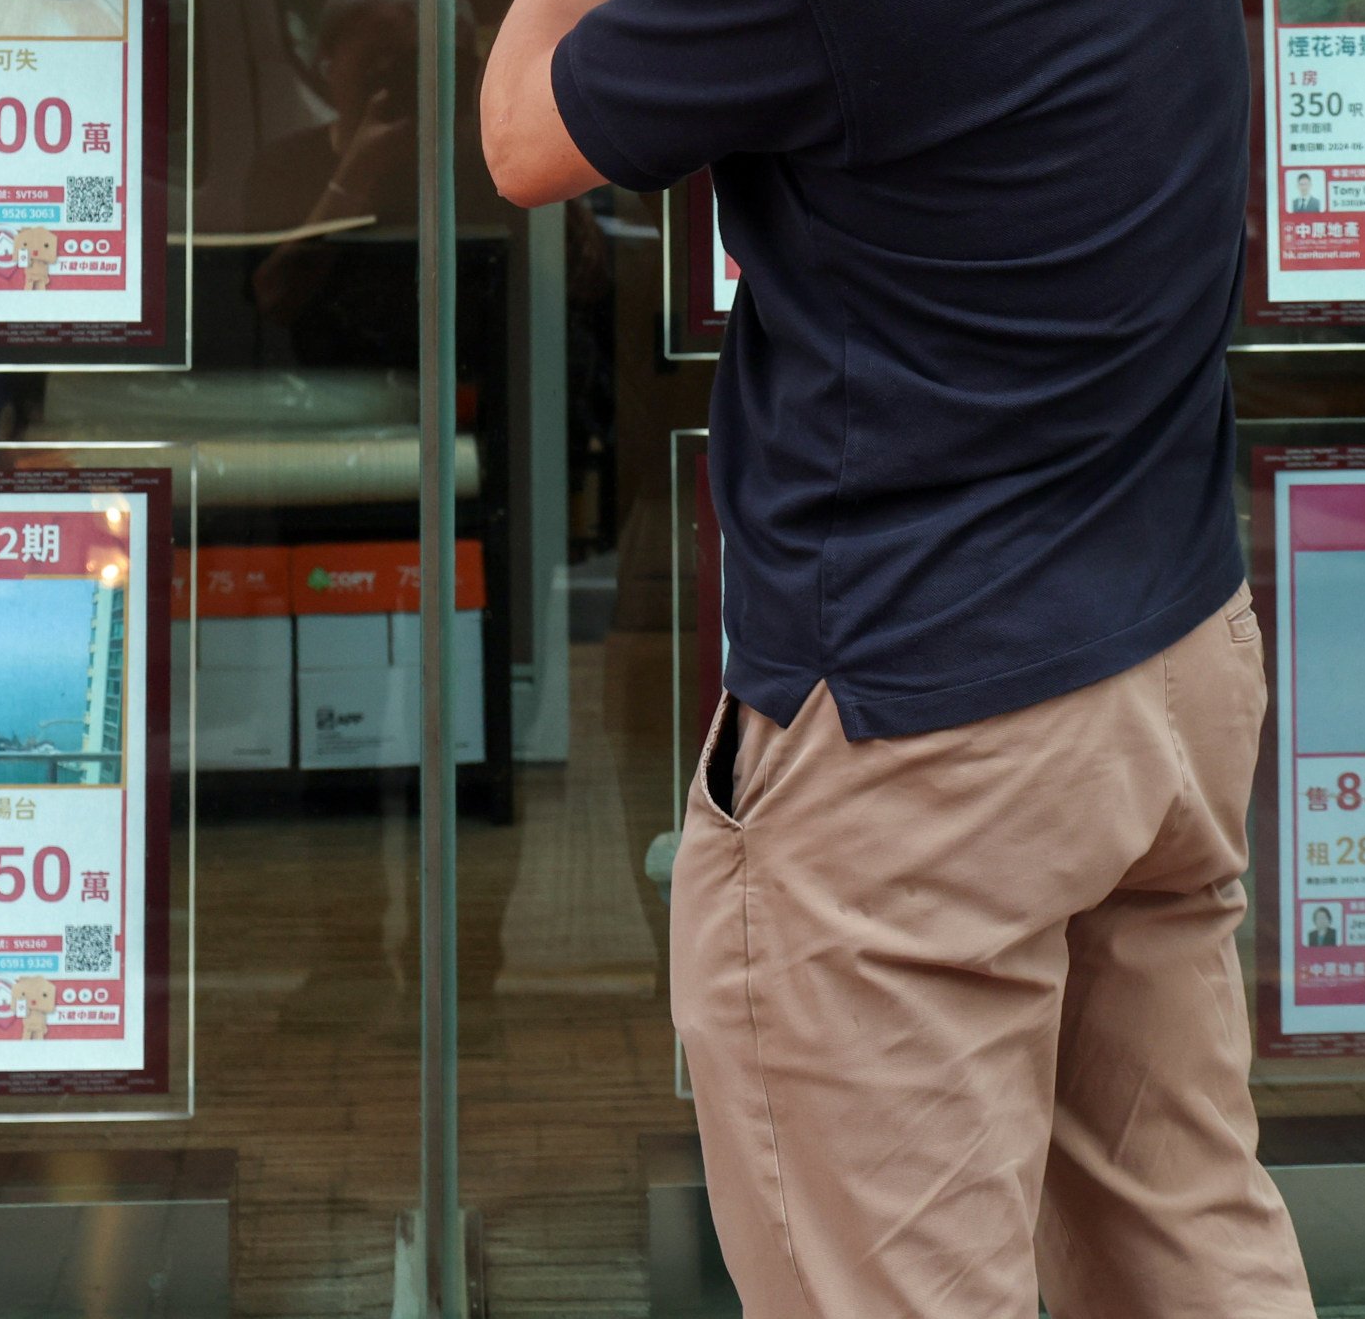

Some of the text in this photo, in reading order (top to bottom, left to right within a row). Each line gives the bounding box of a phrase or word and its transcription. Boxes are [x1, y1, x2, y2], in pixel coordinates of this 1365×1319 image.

[1333, 186, 1359, 197] Tony
[1295, 222, 1359, 238] 中原地產
